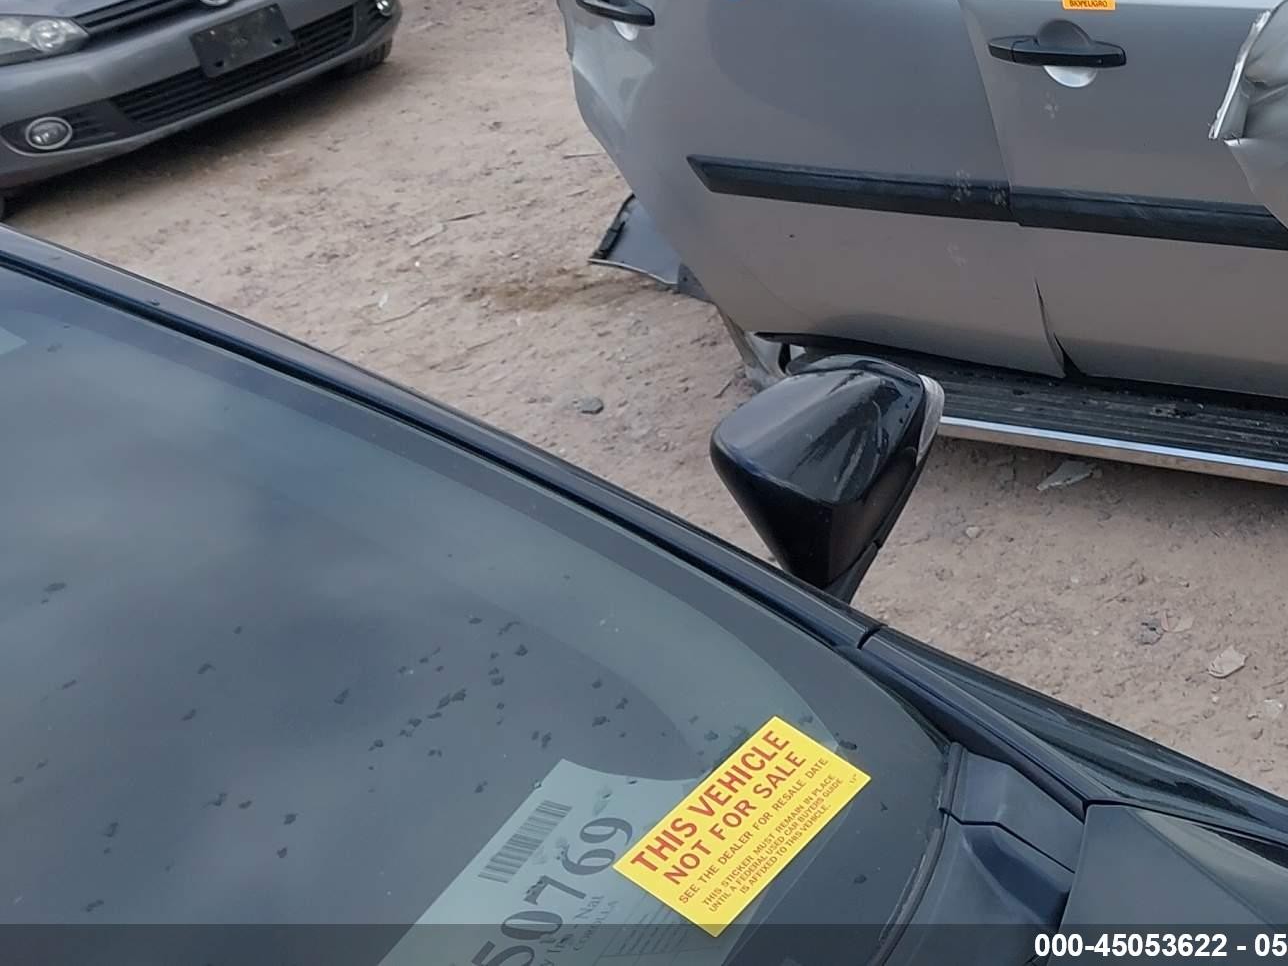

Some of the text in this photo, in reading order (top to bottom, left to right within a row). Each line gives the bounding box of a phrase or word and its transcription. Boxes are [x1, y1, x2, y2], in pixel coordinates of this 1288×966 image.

[630, 730, 790, 872] THIS VEHICLE
[663, 751, 806, 885] NOT FOR SALE
[678, 884, 700, 904] SEE
[697, 864, 720, 883] THE
[717, 831, 753, 865] DEALER
[752, 812, 773, 831] FOR
[771, 779, 806, 811] RESALE
[805, 758, 828, 779] DATE
[702, 888, 722, 905] THIS
[721, 855, 754, 887] STICKER
[753, 833, 775, 855] MUST
[775, 804, 805, 833] REMAIN
[803, 795, 814, 805] IN
[811, 775, 835, 797] PLACE
